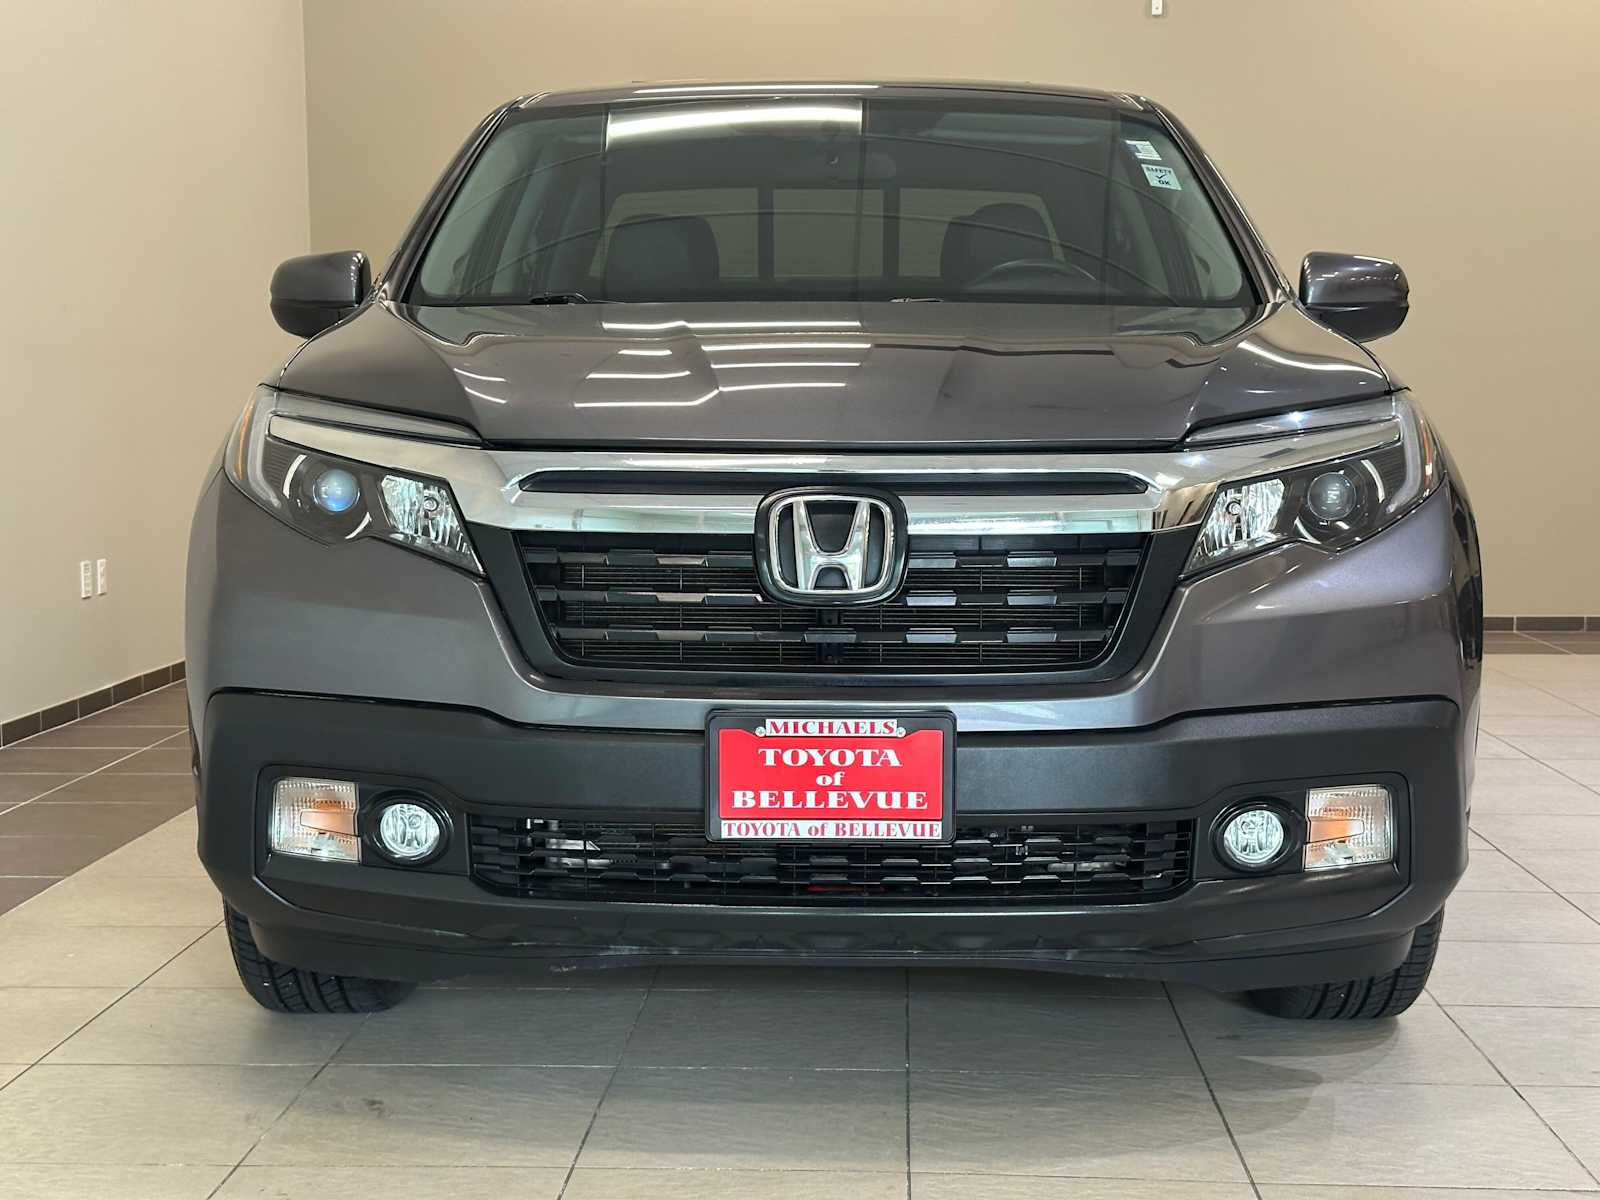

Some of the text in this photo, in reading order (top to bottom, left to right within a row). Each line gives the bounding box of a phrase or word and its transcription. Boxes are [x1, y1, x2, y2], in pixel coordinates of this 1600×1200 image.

[769, 720, 895, 735] MICHAELS
[758, 748, 903, 767] TOYOTA
[816, 771, 845, 786] of
[731, 790, 928, 809] BELLEVUE
[723, 822, 941, 838] TOYOTA of BELLEVUE
